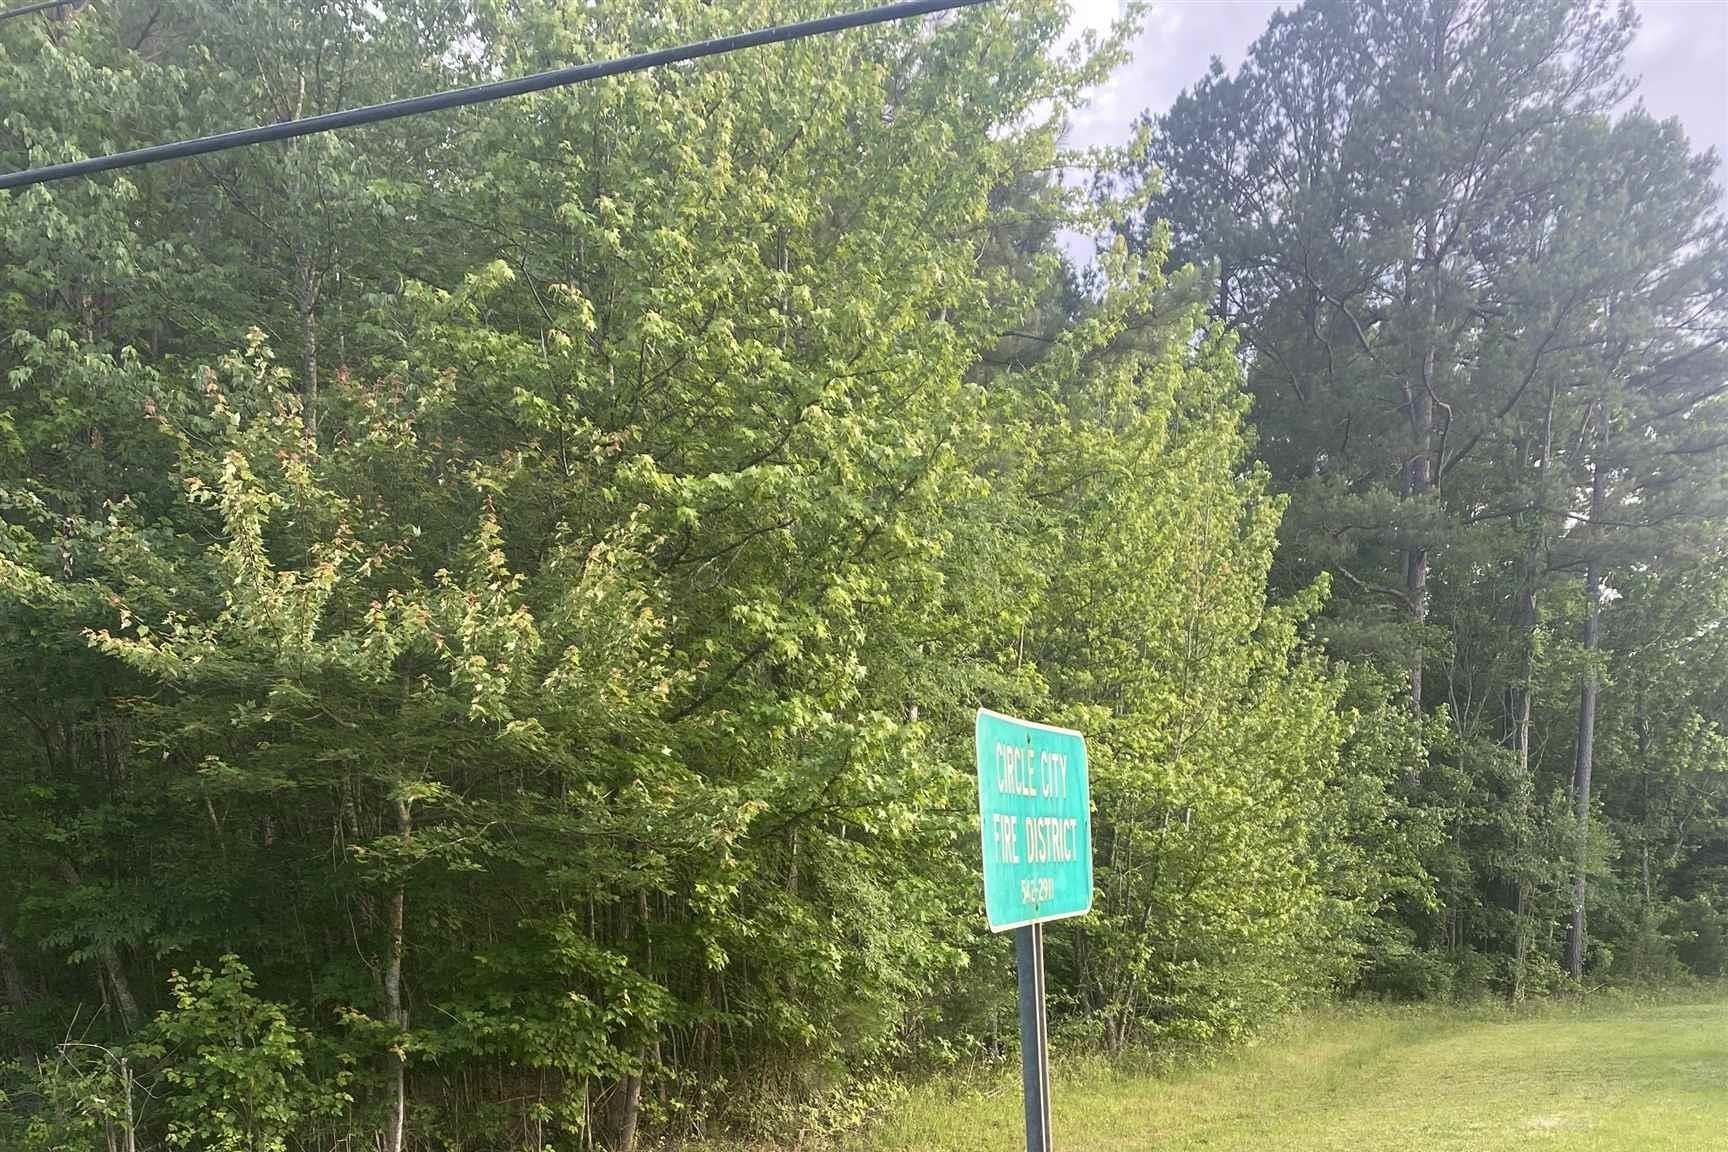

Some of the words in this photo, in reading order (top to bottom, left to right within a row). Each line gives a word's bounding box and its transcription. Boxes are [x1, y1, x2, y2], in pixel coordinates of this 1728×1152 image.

[995, 742, 1037, 796] CIRCLE
[1040, 751, 1067, 798] CITY
[992, 813, 1020, 864] FIRE
[1026, 818, 1077, 864] DISTRICT
